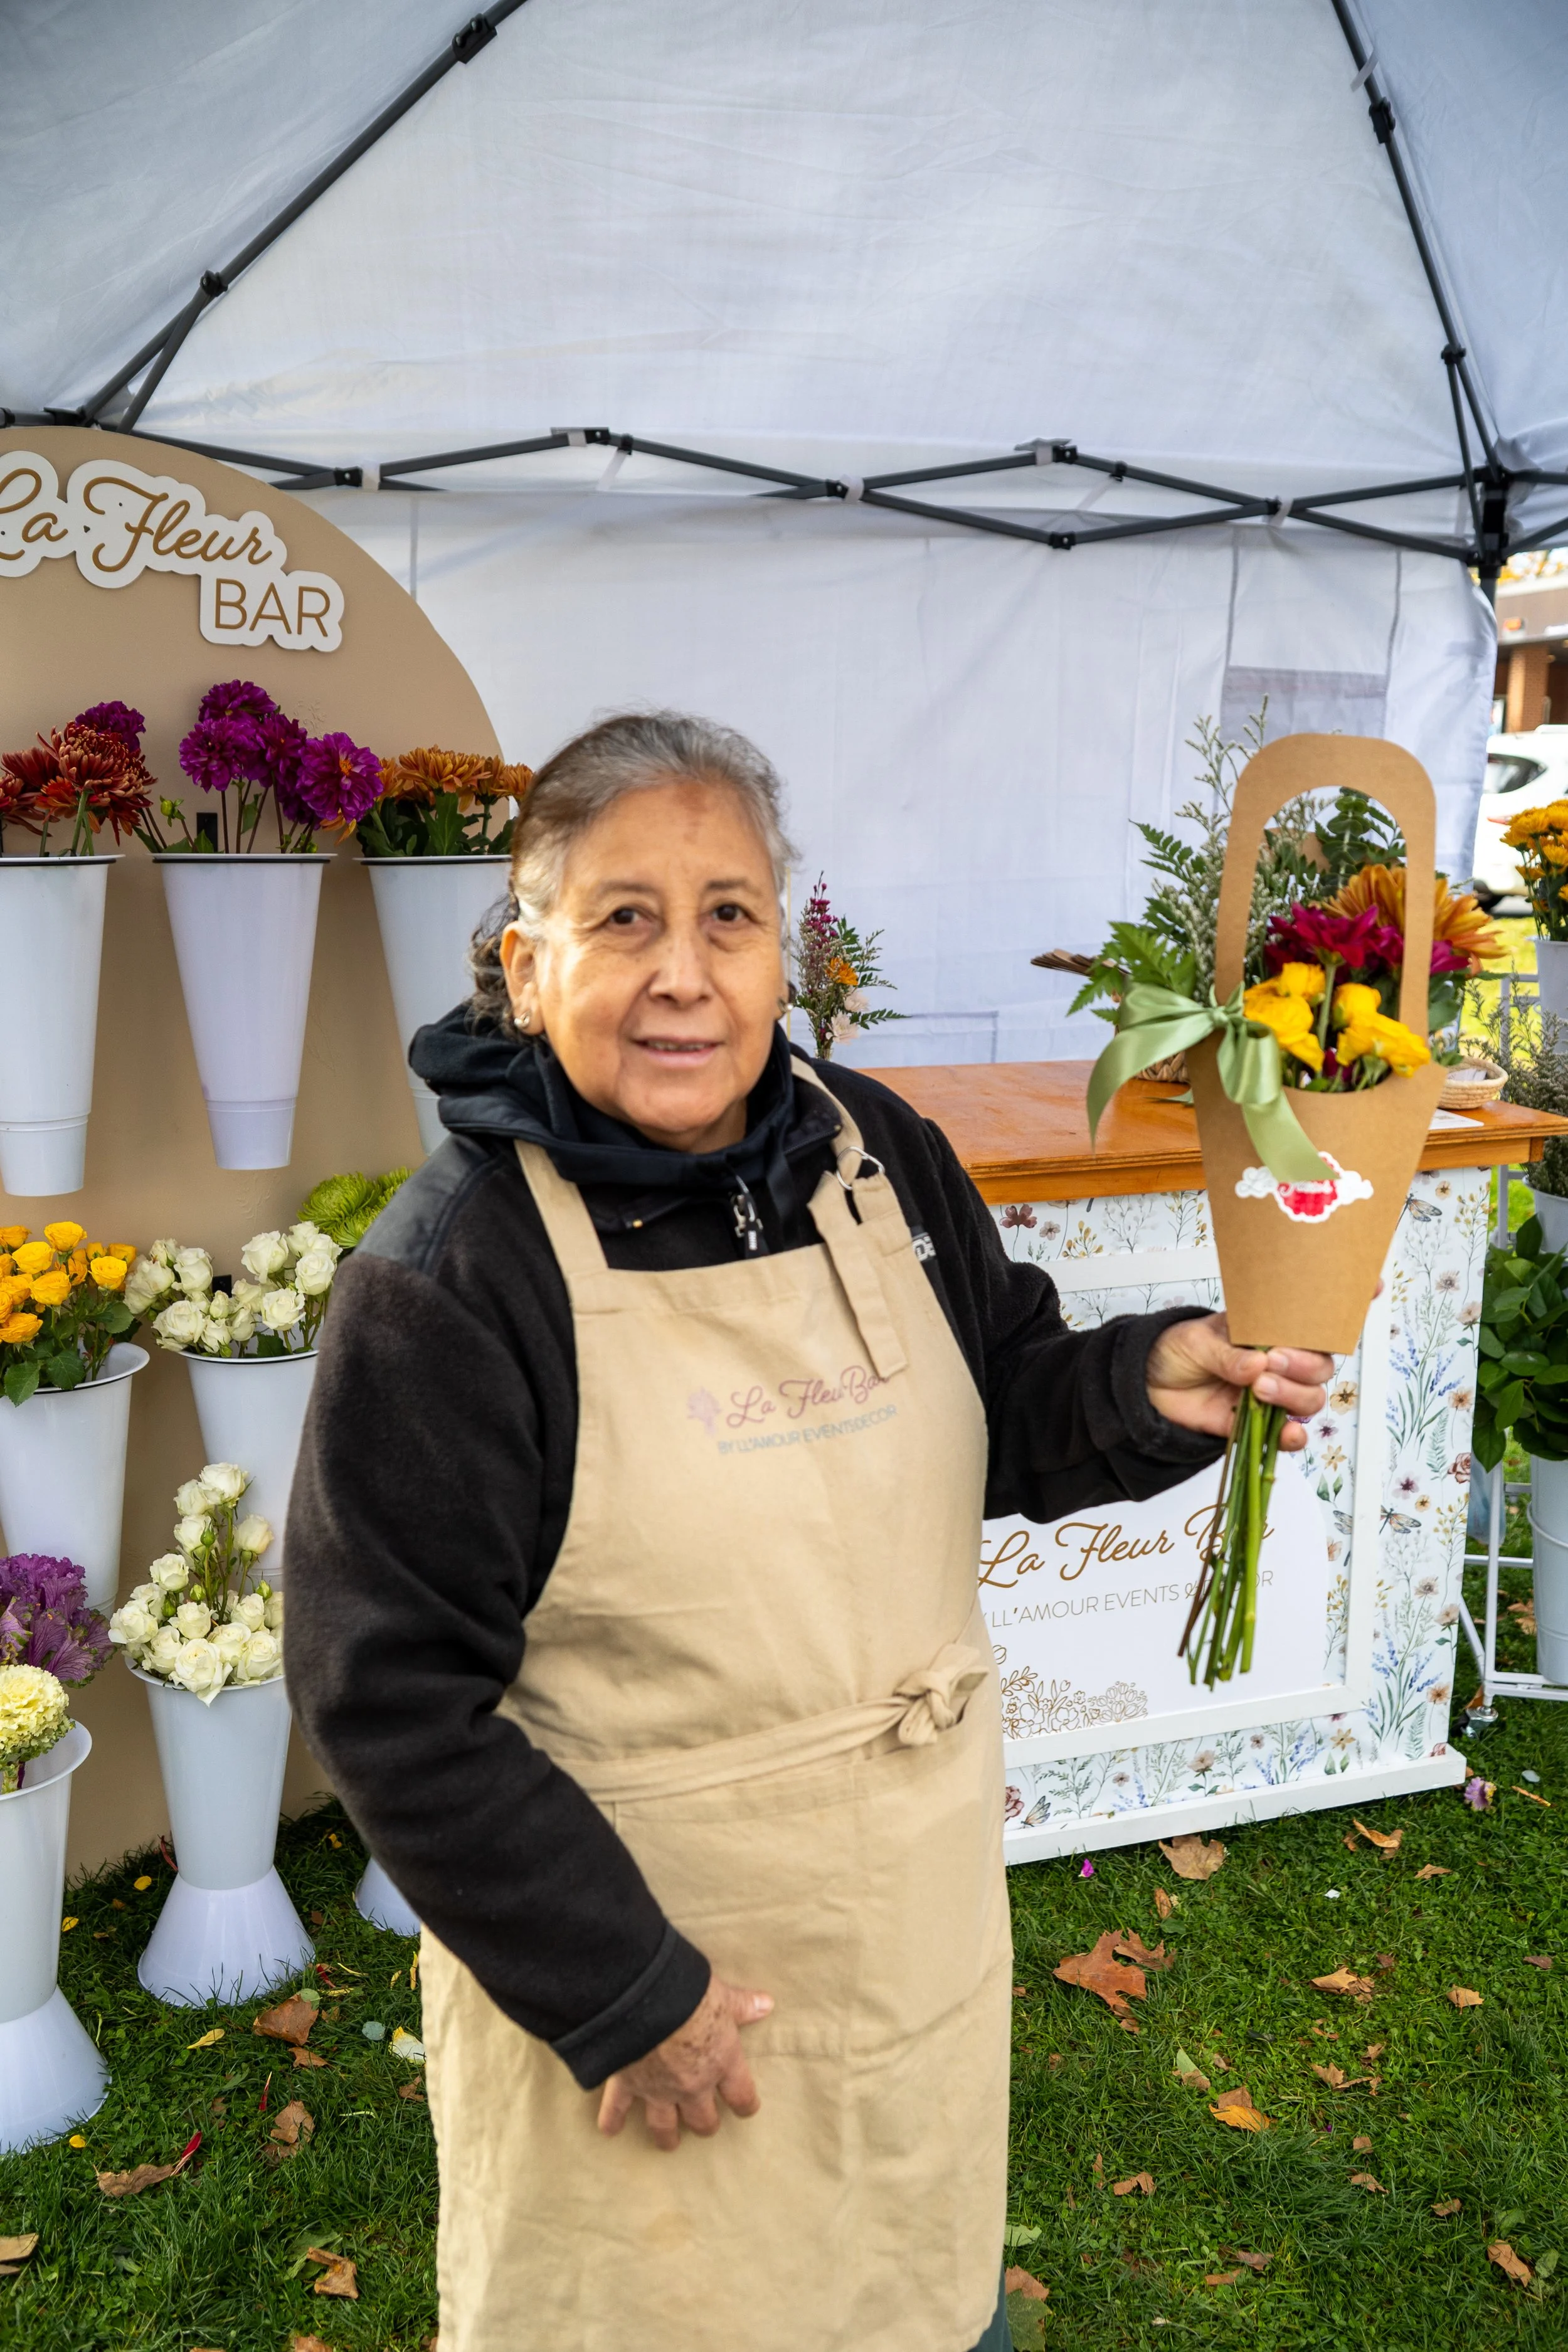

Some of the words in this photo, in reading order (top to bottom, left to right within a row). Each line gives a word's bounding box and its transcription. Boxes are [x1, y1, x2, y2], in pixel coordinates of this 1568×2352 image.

[0, 467, 69, 561] La
[83, 476, 273, 573] Fleur
[215, 577, 331, 637] BAR
[726, 1385, 777, 1429] La
[977, 1530, 1046, 1590] La
[1055, 1522, 1175, 1581] Fleur
[992, 1595, 1098, 1628] LL'AMOUR
[1104, 1584, 1180, 1612] EVENTS
